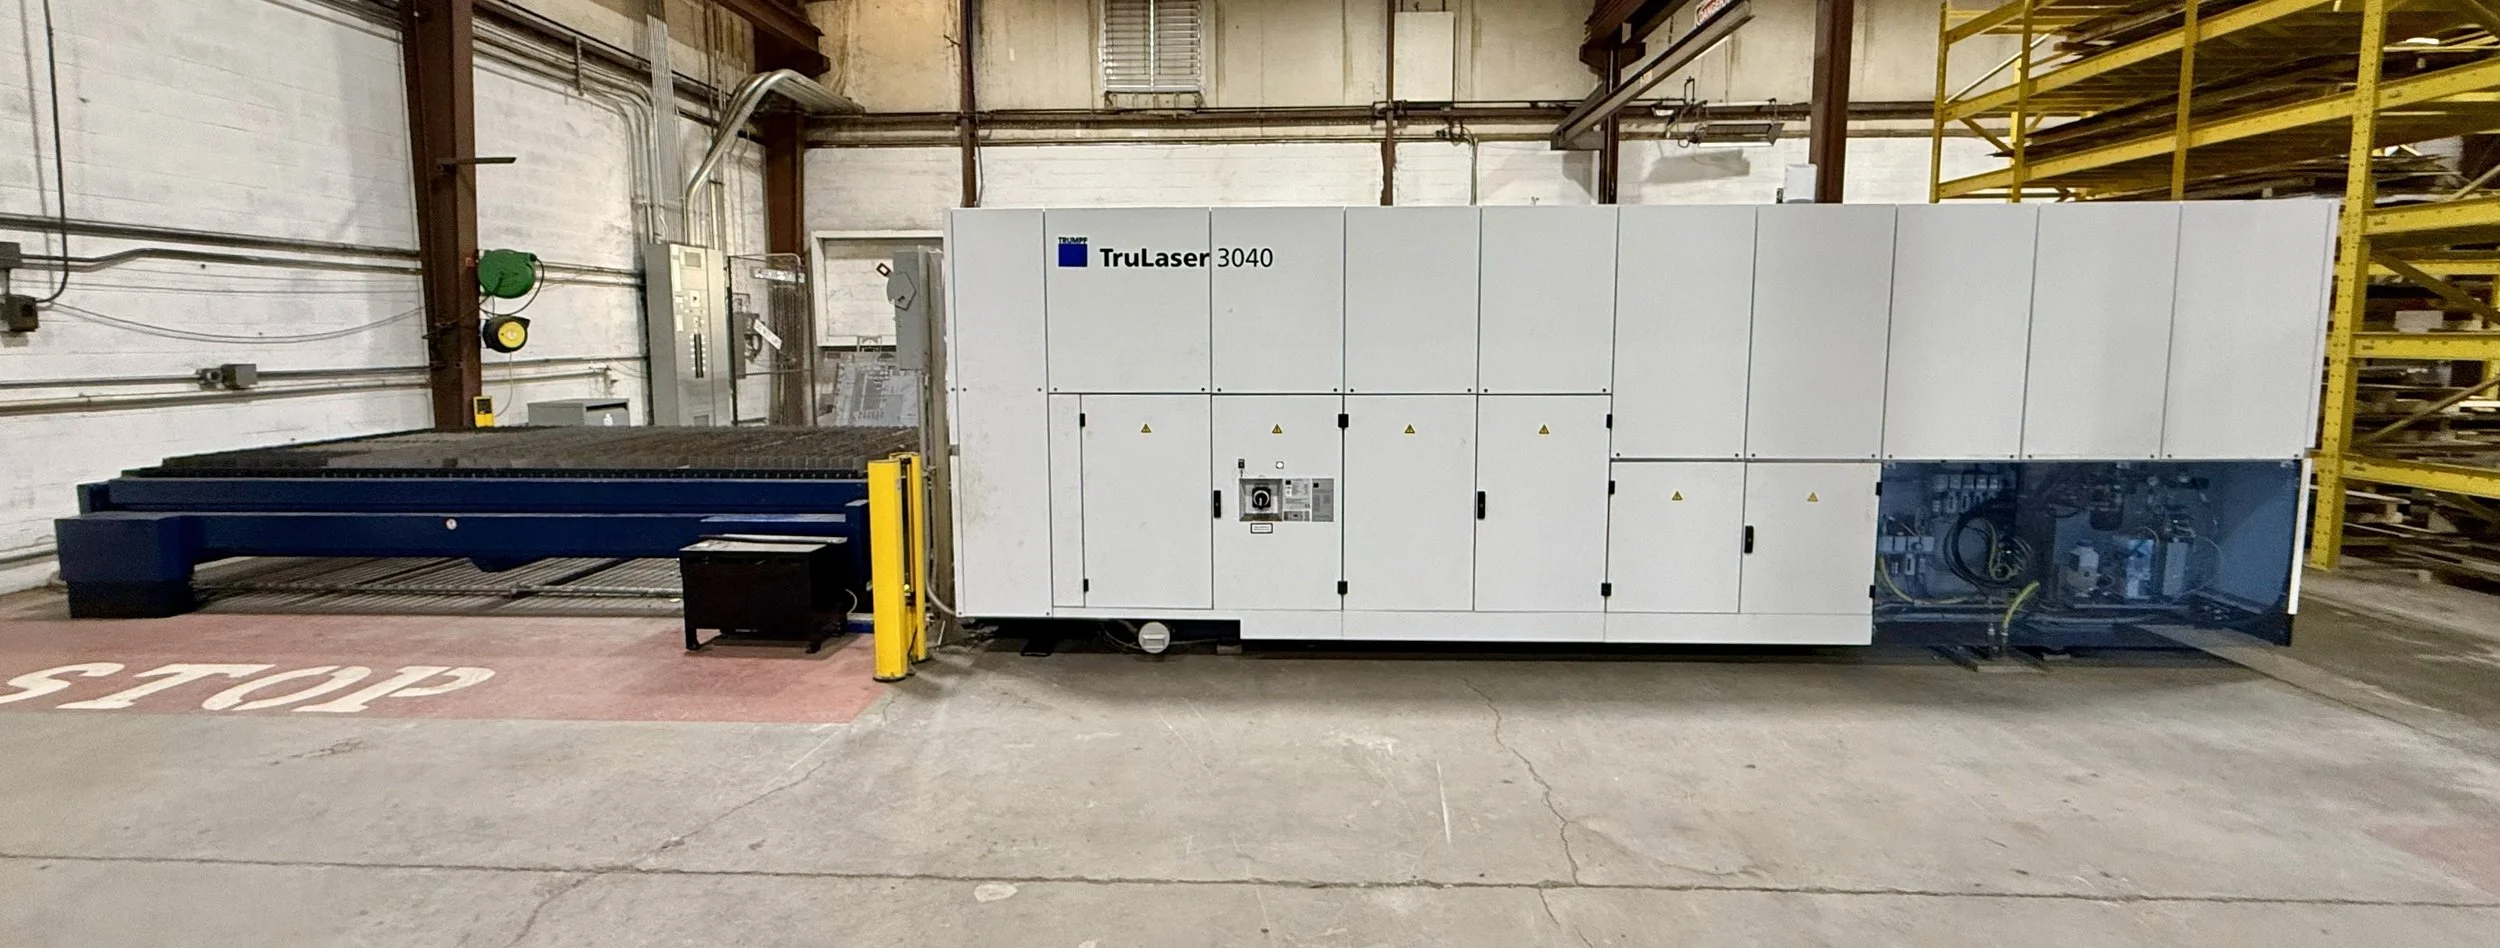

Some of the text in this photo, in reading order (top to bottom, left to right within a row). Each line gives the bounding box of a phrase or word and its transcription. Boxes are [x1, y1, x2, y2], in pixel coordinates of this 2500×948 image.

[1058, 236, 1088, 244] TRUMPF
[1099, 248, 1273, 267] TruLaser 3040
[0, 662, 495, 713] STOP
